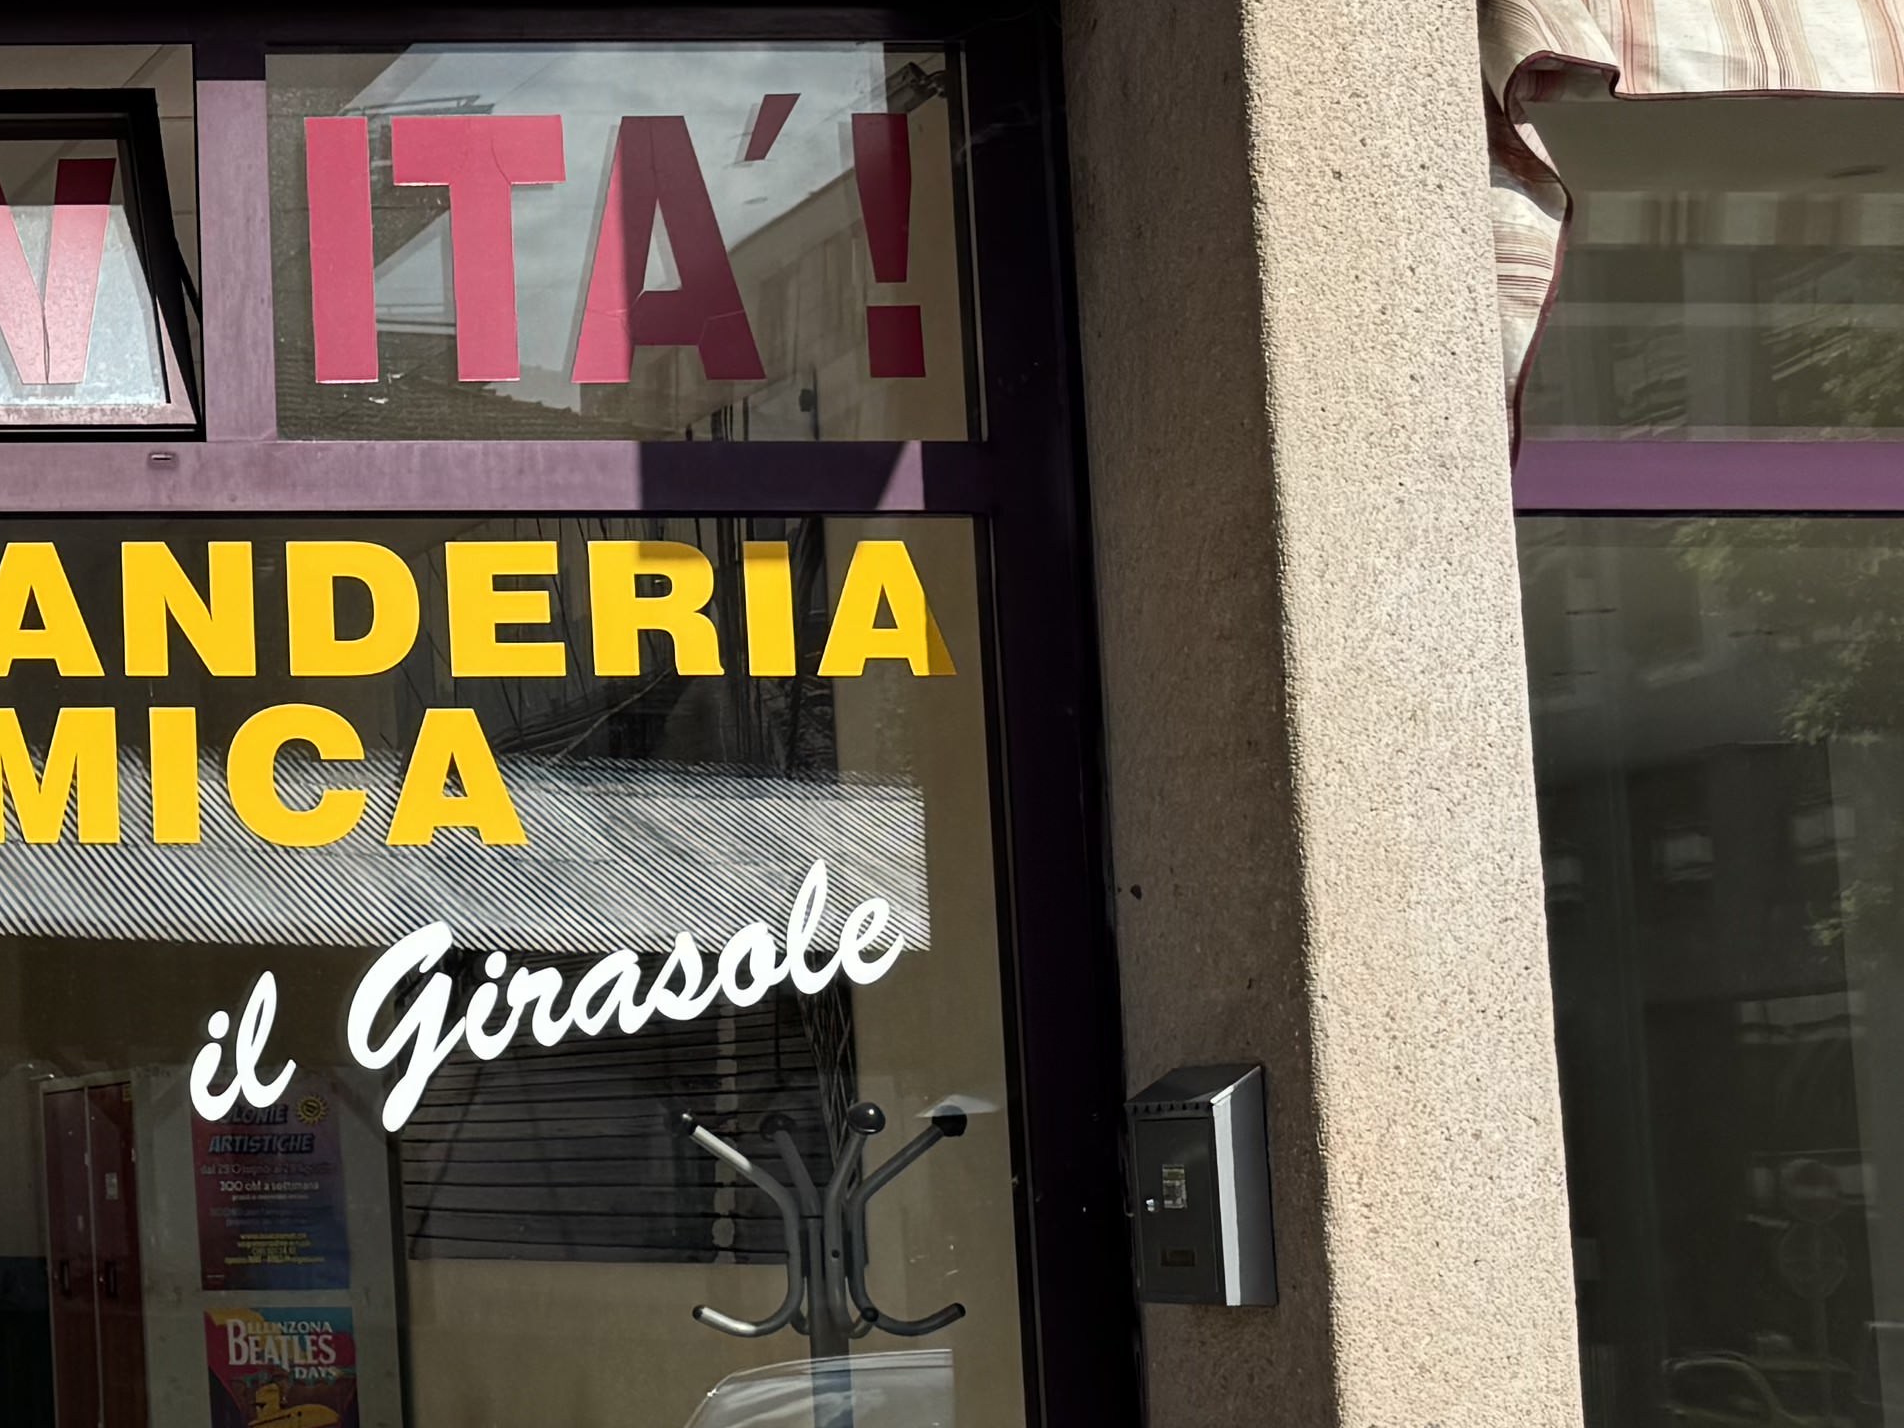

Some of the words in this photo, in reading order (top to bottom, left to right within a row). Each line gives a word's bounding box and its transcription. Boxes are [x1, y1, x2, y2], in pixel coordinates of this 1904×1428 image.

[189, 970, 295, 1124] il
[348, 859, 905, 1134] Girasole
[208, 1133, 315, 1154] ARTISTICHE
[226, 1320, 337, 1370] BEATLES
[294, 1366, 338, 1379] DAYS
